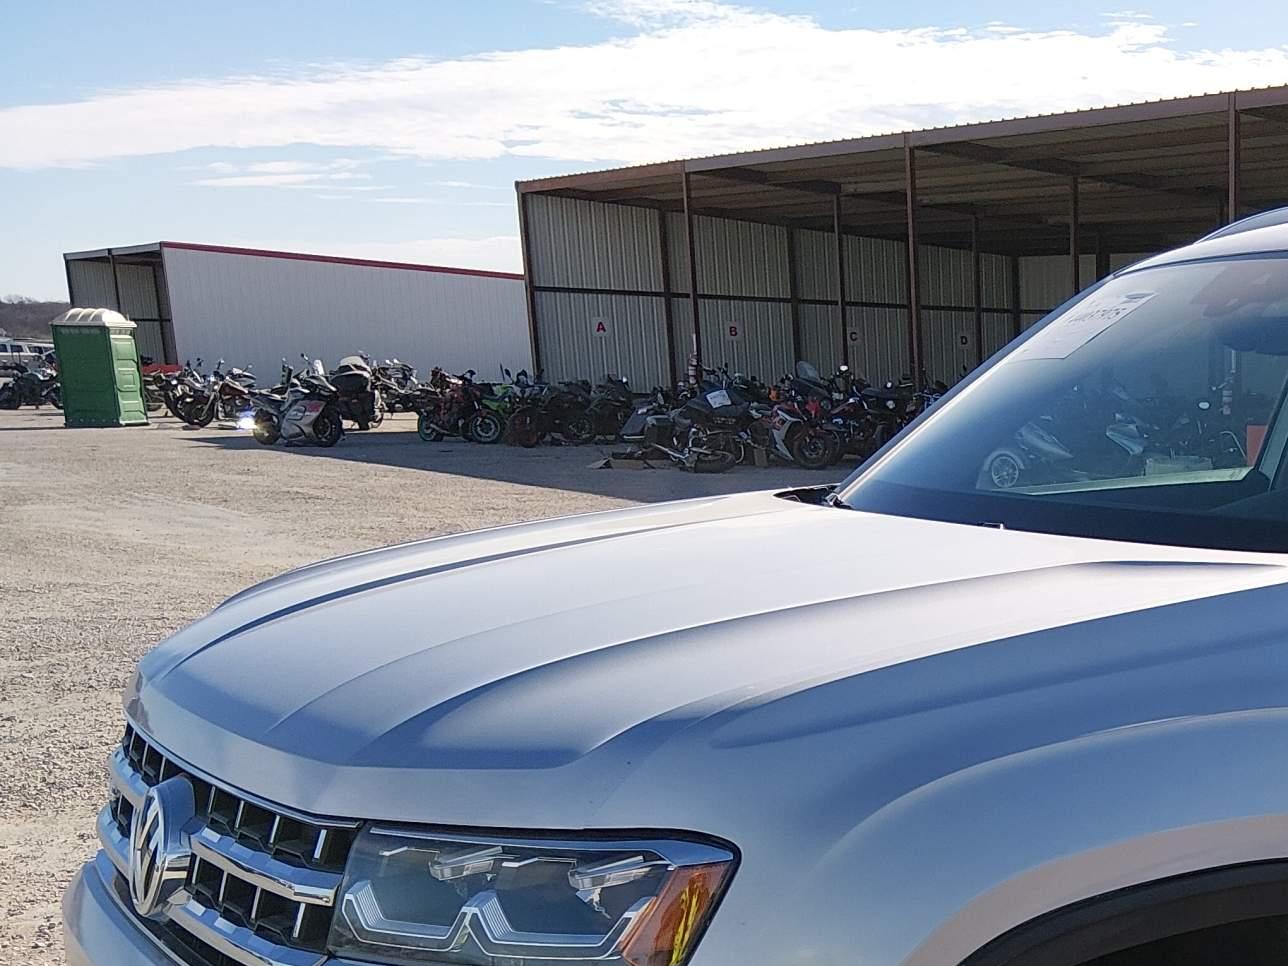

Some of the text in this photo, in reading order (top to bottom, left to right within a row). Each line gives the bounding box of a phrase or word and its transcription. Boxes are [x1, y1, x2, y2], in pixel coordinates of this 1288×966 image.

[596, 321, 606, 333] A
[729, 326, 738, 337] B
[849, 331, 858, 342] C
[960, 335, 969, 346] D
